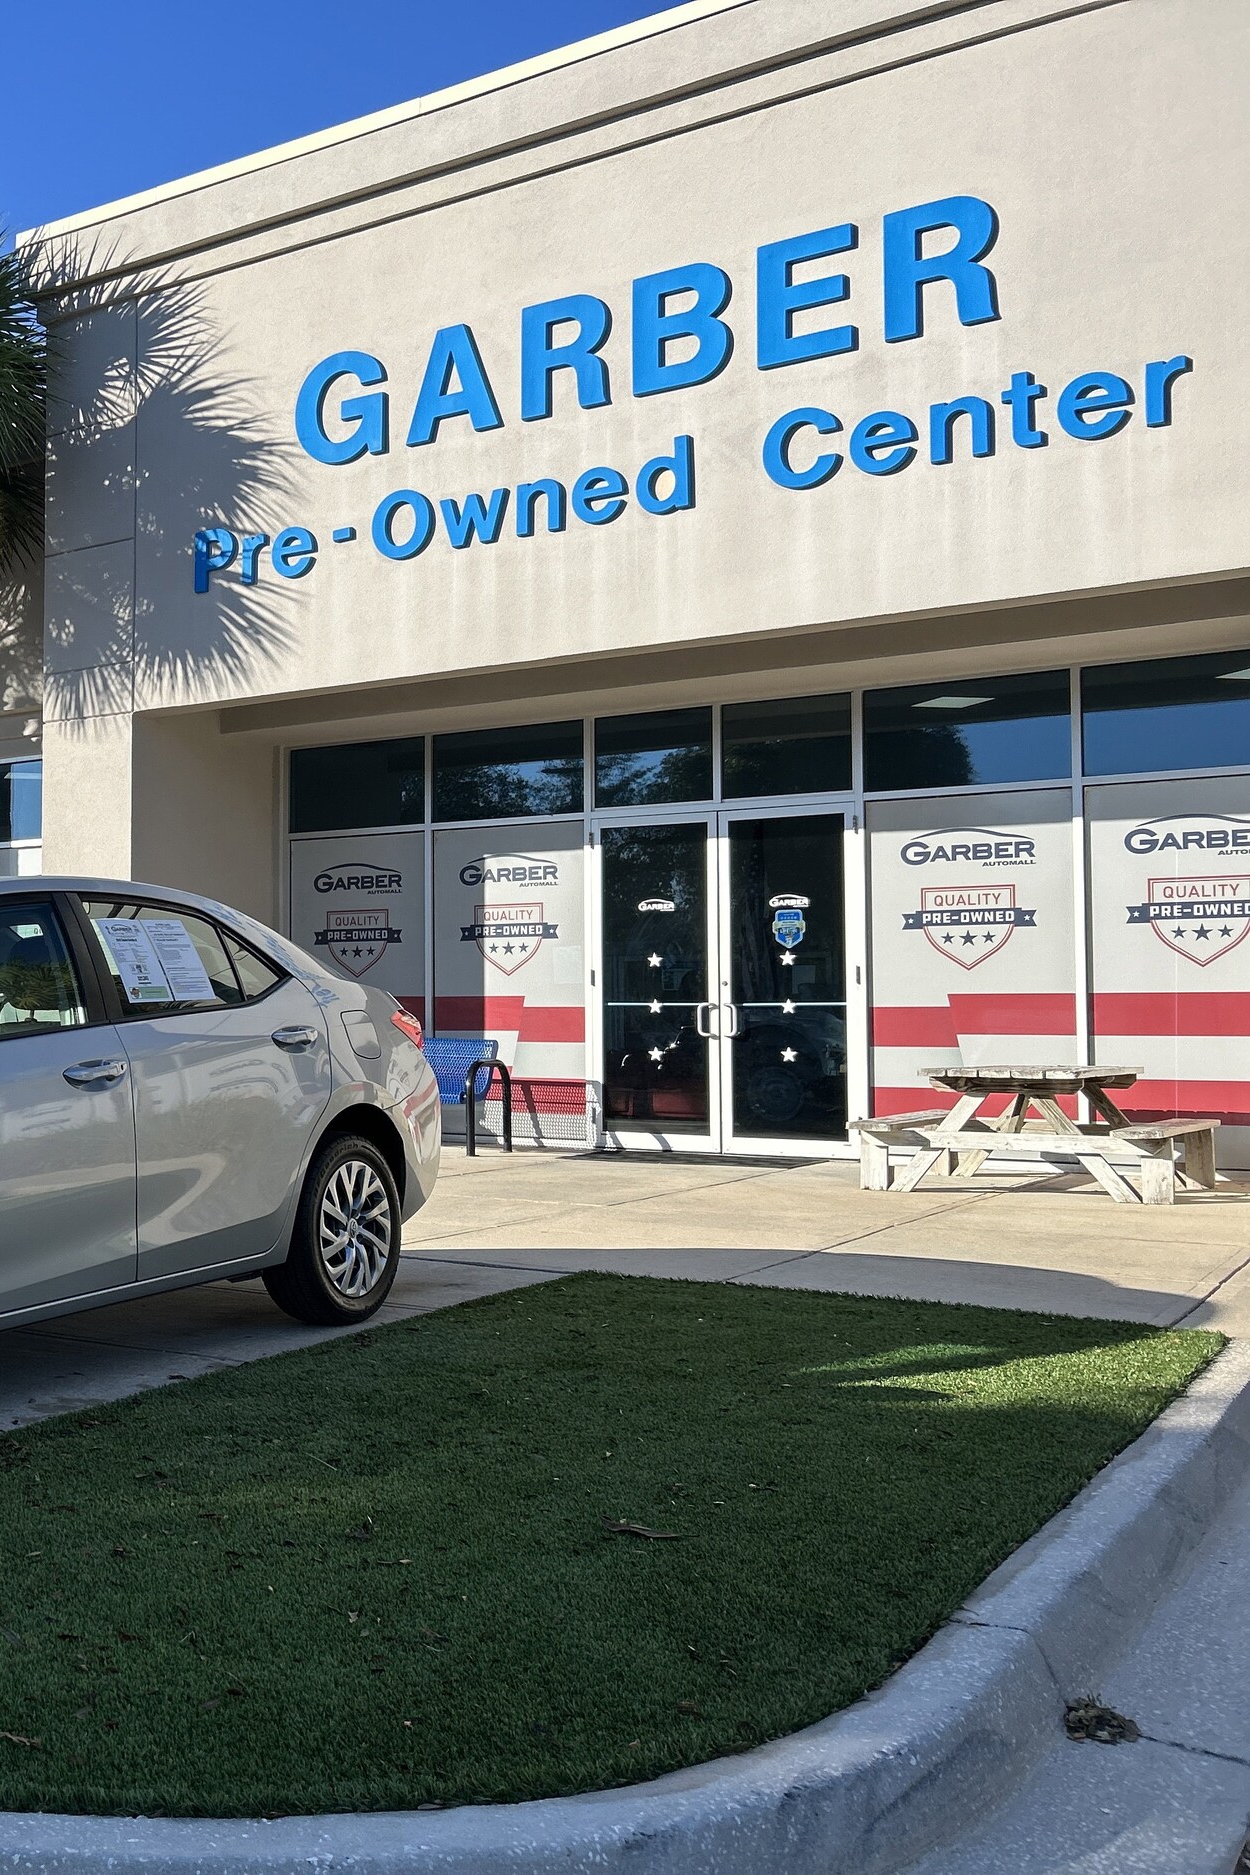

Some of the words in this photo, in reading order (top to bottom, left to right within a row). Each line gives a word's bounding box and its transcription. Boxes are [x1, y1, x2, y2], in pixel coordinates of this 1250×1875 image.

[295, 195, 1004, 467] GARBER
[762, 355, 1192, 491] Center
[1124, 828, 1250, 854] GARBE
[900, 841, 1036, 865] GARBER
[982, 859, 1036, 867] AUTOMALL
[459, 865, 558, 886] GARBER
[313, 873, 402, 893] GARBER
[1163, 884, 1239, 898] QUALITY
[934, 893, 1001, 907] QUALITY
[335, 916, 379, 927] QUALITY
[483, 910, 533, 921] QUALITY
[922, 910, 1015, 924] PRE-OWNED
[327, 929, 388, 940] PRE-OWNED
[475, 924, 543, 936] PRE-OWNED
